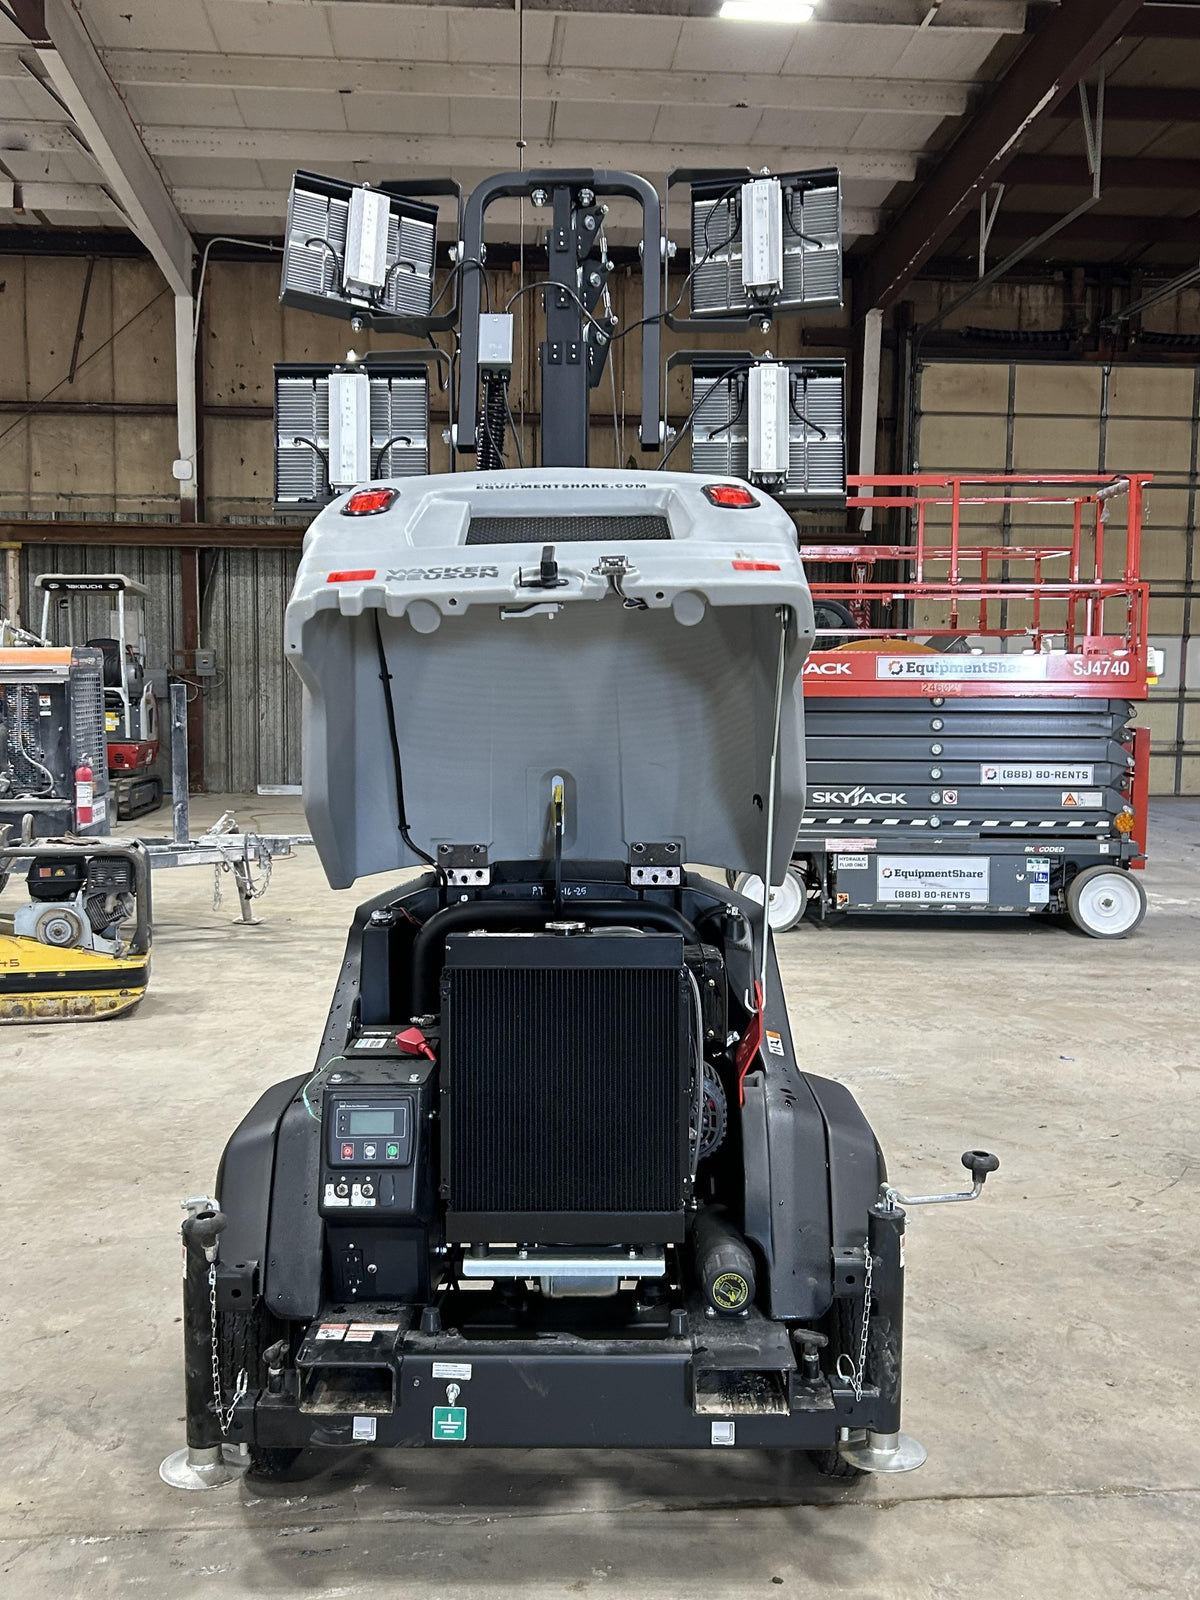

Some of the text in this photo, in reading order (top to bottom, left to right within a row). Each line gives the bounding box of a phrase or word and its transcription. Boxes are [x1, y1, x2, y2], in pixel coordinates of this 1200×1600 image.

[476, 482, 647, 490] EQUIPMENTSHARE.COM
[387, 566, 498, 576] WACKER
[385, 572, 499, 581] NEUSON
[906, 661, 1033, 676] EquipmentShar
[1073, 660, 1130, 676] SJ4740
[1002, 770, 1089, 780] (888) 80-RENTS
[812, 786, 907, 806] SKYJACK
[894, 868, 984, 880] EquipmentShare
[894, 889, 971, 899] (888) 80-RENTS
